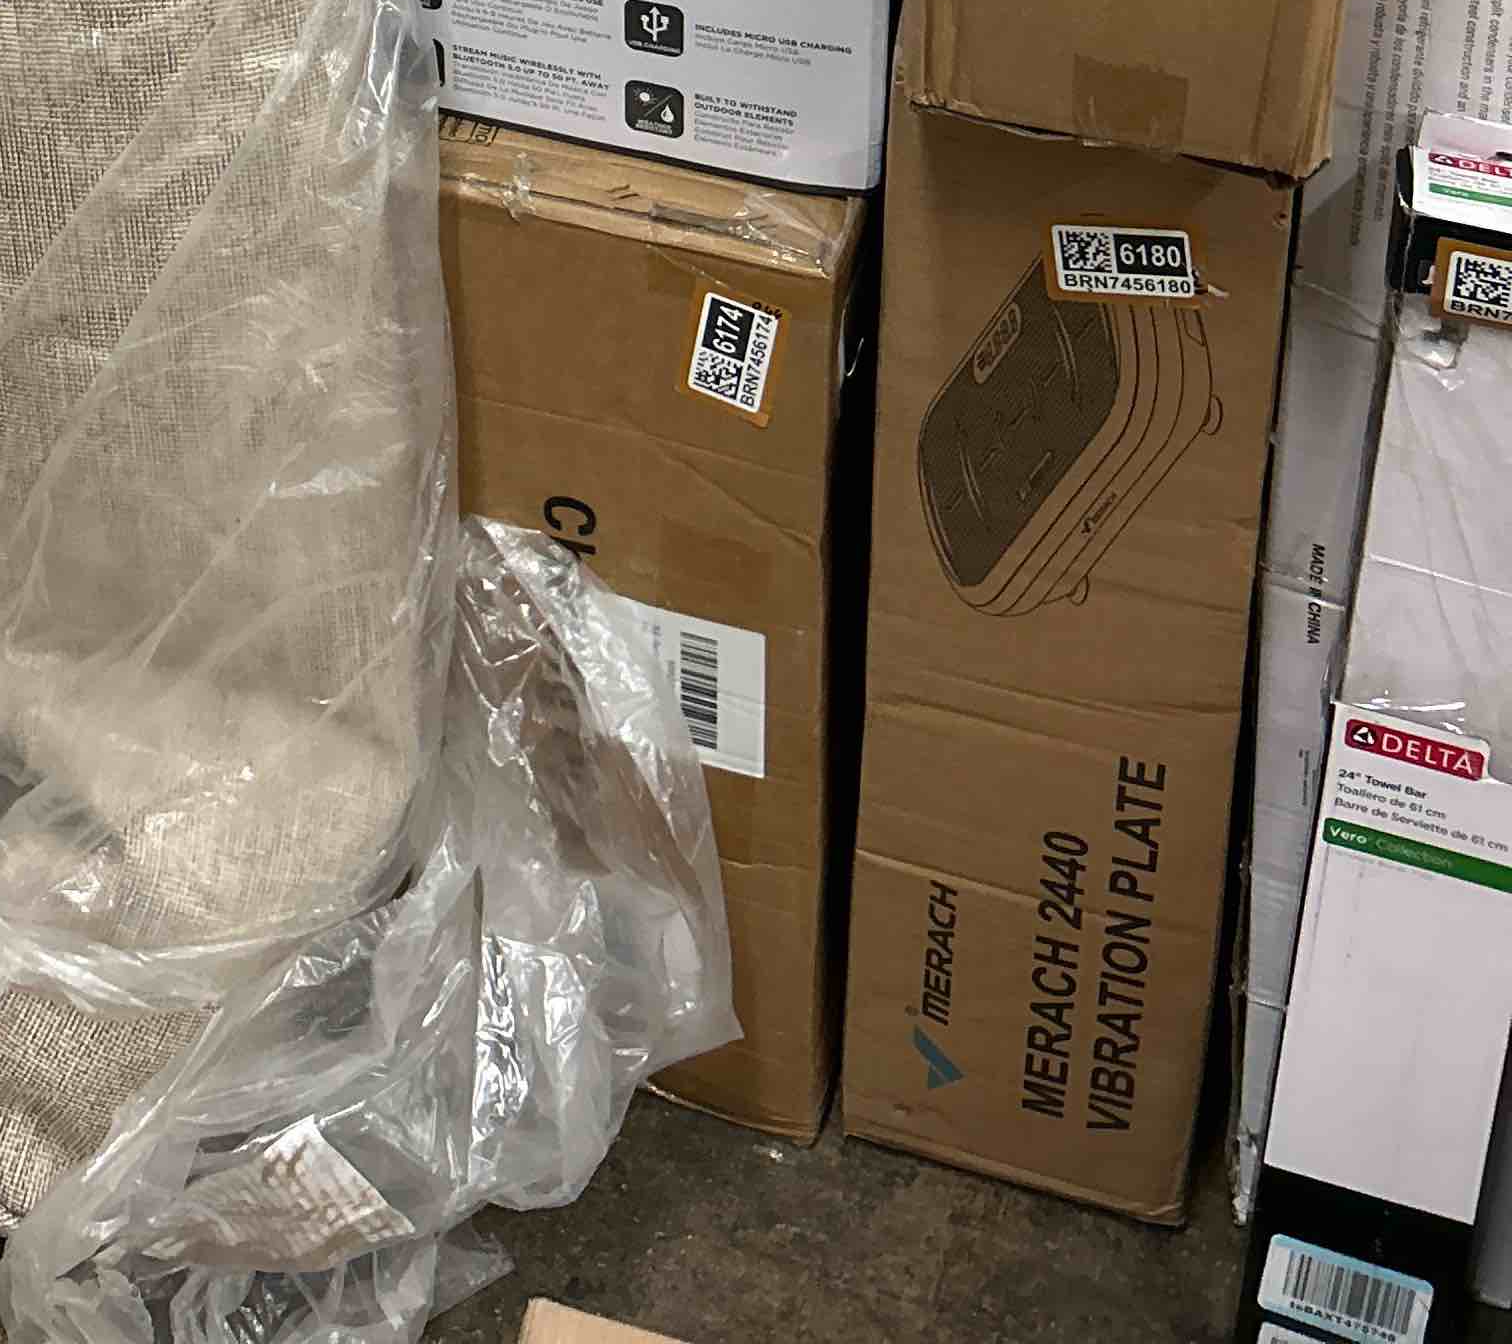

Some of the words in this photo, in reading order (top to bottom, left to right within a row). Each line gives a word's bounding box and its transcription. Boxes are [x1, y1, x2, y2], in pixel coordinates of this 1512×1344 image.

[695, 23, 743, 39] INCLUDES
[744, 31, 777, 44] MICRO
[778, 37, 798, 49] USB
[799, 40, 853, 55] CHARGING
[452, 44, 488, 58] STREAM
[489, 51, 518, 64] MUSIC
[519, 57, 576, 76] WIRELESSLY
[576, 69, 602, 81] WITH
[452, 52, 506, 70] BLUETOOTH
[523, 67, 536, 76] UP
[580, 78, 610, 91] AWAY
[694, 93, 722, 106] BUILT
[739, 101, 798, 118] WITHSTAND
[694, 101, 743, 118] OUTDOOR
[744, 111, 795, 128] ELEMENTS
[1118, 243, 1182, 268] 6180
[1063, 273, 1191, 295] BRN7456180
[711, 305, 745, 355] 6174
[739, 313, 774, 407] BRN7456174
[1310, 542, 1326, 583] MADE
[1304, 601, 1324, 645] CHINA
[1380, 732, 1474, 775] DELTA
[1336, 782, 1388, 804] Toallero
[1389, 796, 1407, 809] de
[1425, 808, 1447, 820] cm
[1364, 774, 1402, 793] Towel
[1404, 785, 1428, 800] Bar
[1108, 755, 1167, 903] PLATE
[1329, 825, 1368, 845] Vero
[1334, 796, 1369, 814] Barre
[1371, 805, 1389, 819] de
[1391, 811, 1449, 837] Serviette
[1450, 829, 1469, 842] de
[1487, 839, 1509, 853] cm
[1037, 830, 1089, 931] 2440
[1021, 934, 1081, 1120] MERACH
[1085, 908, 1153, 1131] VIBRATION
